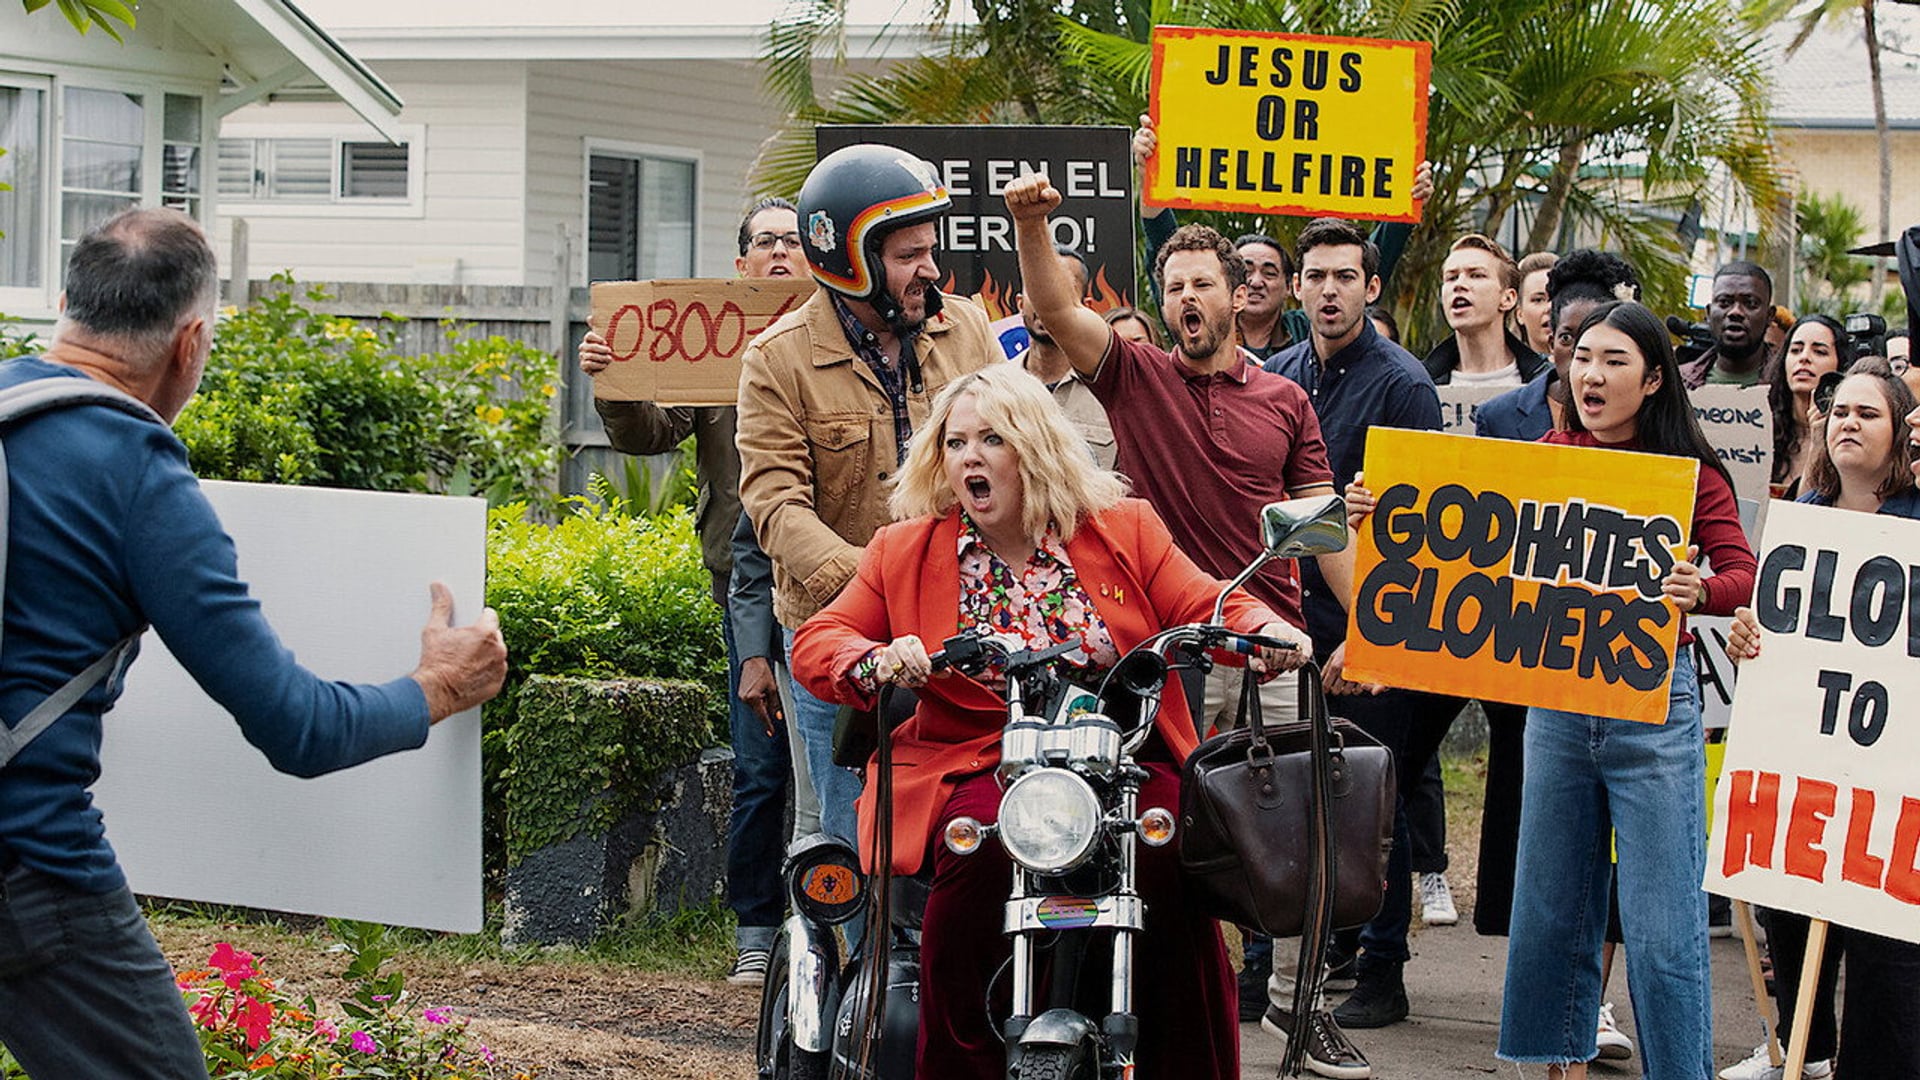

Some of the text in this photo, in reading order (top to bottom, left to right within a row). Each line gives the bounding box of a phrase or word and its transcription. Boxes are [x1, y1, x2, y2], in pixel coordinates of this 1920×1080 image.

[1205, 44, 1362, 93] JESUS
[1256, 94, 1319, 141] OR
[1066, 160, 1126, 198] EL
[1175, 147, 1394, 199] HELLFIRE
[1372, 483, 1682, 600] GOD HATES
[1356, 558, 1670, 692] GLOWERS
[1756, 544, 1920, 658] GLO
[1817, 669, 1889, 747] TO
